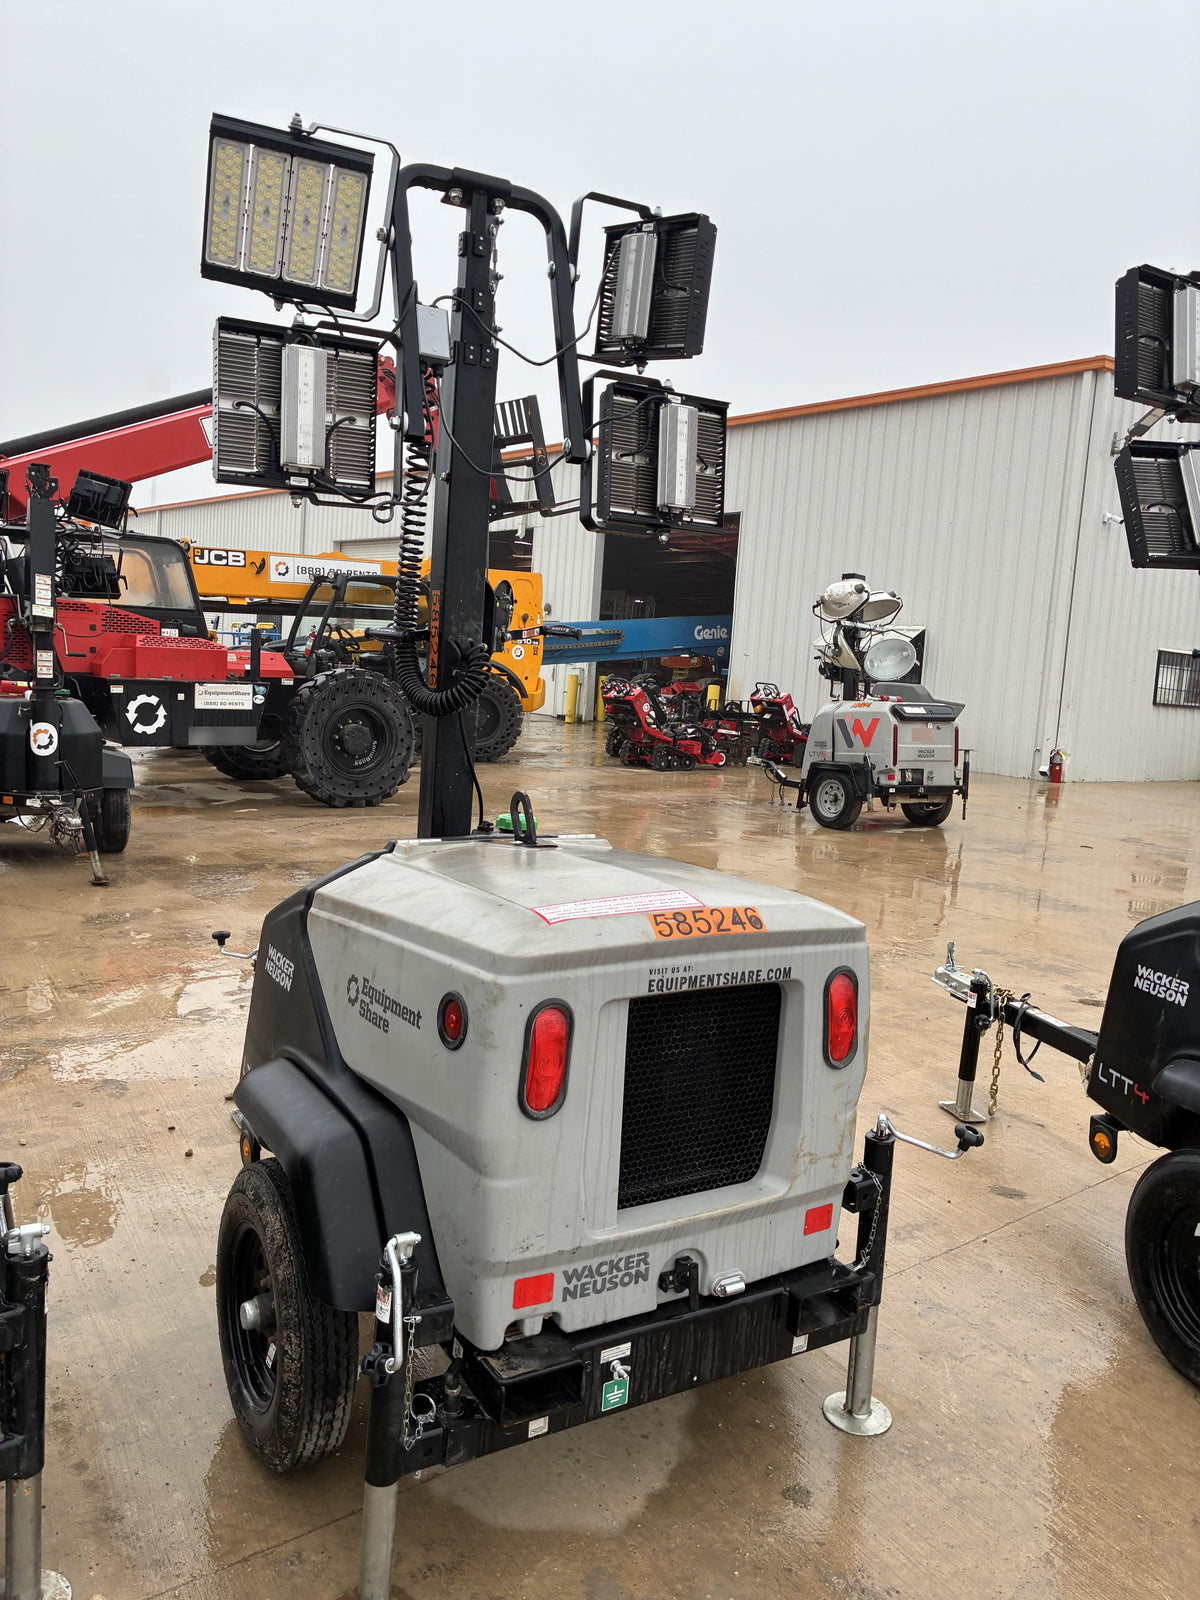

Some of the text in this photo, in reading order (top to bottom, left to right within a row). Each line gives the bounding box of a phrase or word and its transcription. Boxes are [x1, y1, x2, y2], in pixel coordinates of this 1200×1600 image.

[195, 549, 246, 566] JCB
[297, 566, 325, 576] (888)
[428, 593, 440, 687] 585246
[694, 624, 728, 640] Genie
[652, 907, 764, 938] 585246
[265, 957, 292, 992] NEUSON
[268, 943, 295, 978] WACKER
[648, 967, 792, 993] EQUIPMENTSHARE.COM
[1133, 977, 1188, 1007] NEUSON
[1137, 964, 1190, 995] WACKER
[359, 1001, 389, 1034] Share
[361, 977, 422, 1030] Equipment
[1098, 1063, 1150, 1105] LTT4
[562, 1252, 650, 1285] WACKER
[562, 1266, 649, 1302] NEUSON
